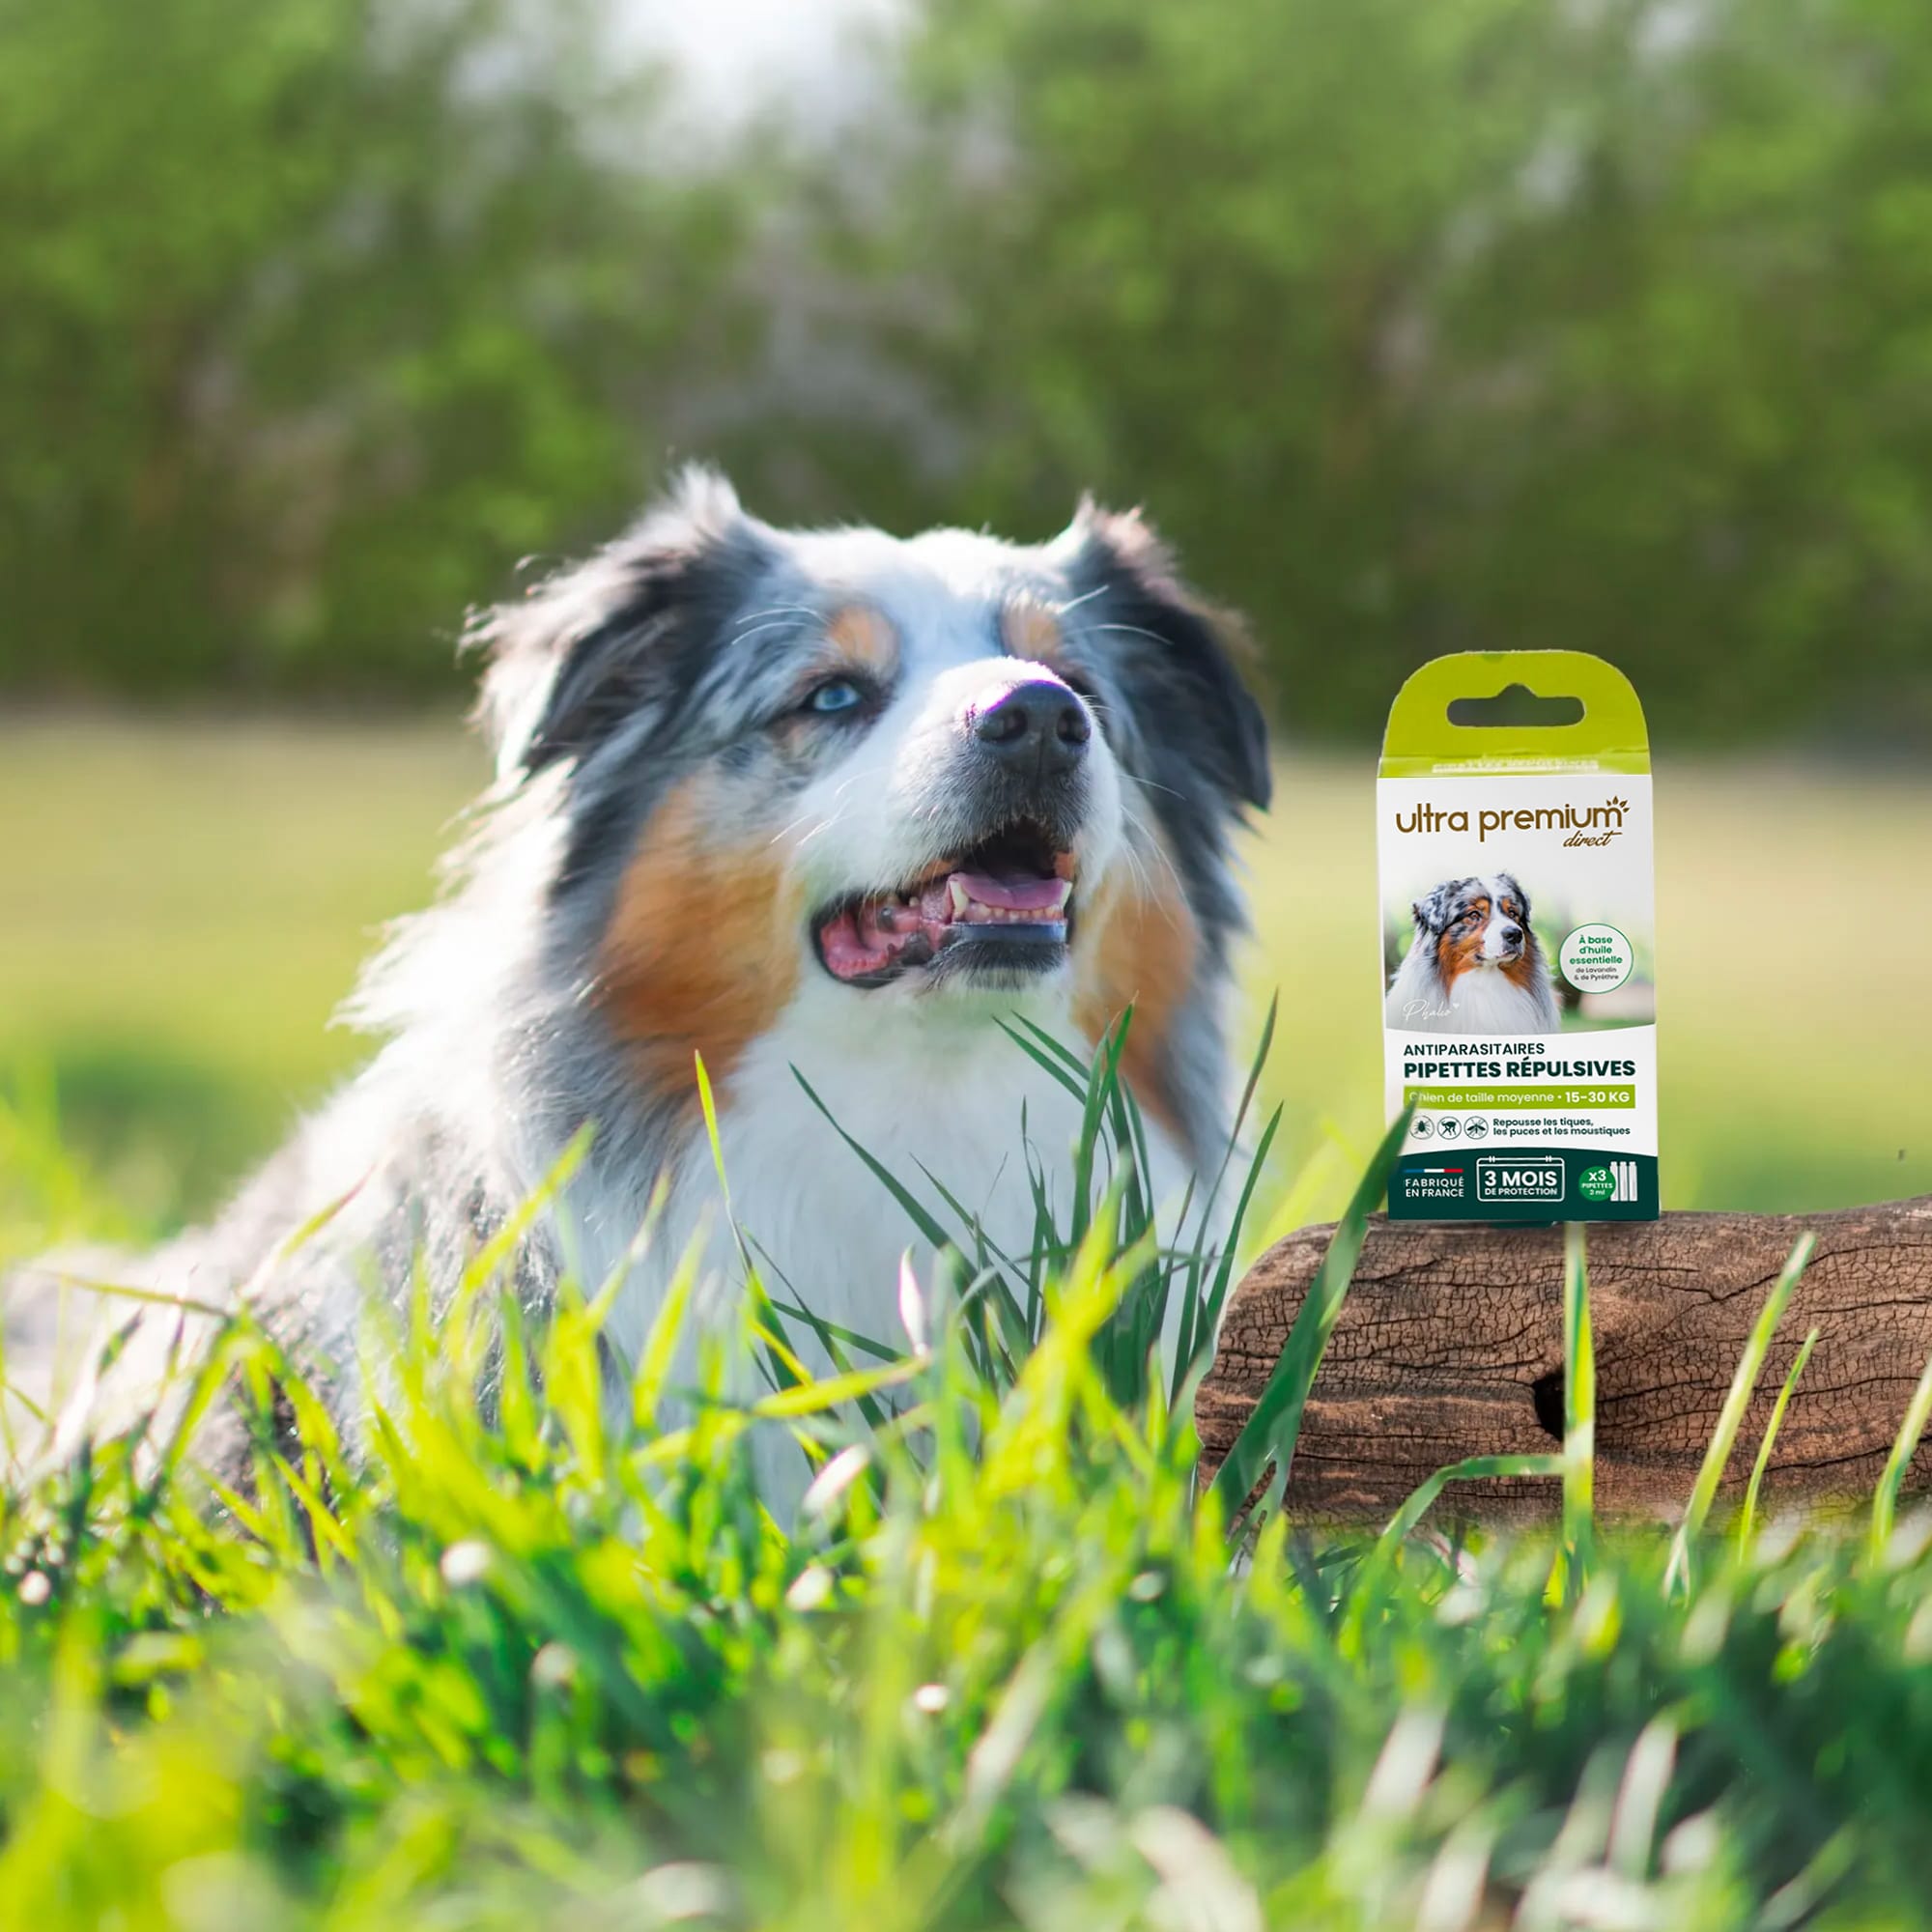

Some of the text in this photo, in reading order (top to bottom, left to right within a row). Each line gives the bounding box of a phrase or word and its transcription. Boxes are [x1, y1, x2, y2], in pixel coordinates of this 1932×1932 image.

[1396, 803, 1622, 842] ultra premium
[1563, 831, 1622, 847] direct
[1579, 946, 1612, 954] d'huile
[1569, 955, 1623, 964] essentielle
[1404, 1043, 1545, 1056] ANTIPARASITAIRES
[1404, 1056, 1635, 1078] PIPETTES RÉPULSIVES
[1447, 1093, 1463, 1102] de
[1465, 1093, 1494, 1102] taille
[1497, 1094, 1554, 1104] moyenne
[1608, 1092, 1630, 1102] KG
[1493, 1119, 1542, 1127] Repousse
[1560, 1118, 1594, 1127] tiques,
[1493, 1127, 1507, 1136] les
[1510, 1128, 1540, 1137] puces
[1571, 1126, 1631, 1137] moustiques
[1485, 1171, 1557, 1186] 3 MOIS
[1588, 1170, 1606, 1181] x3
[1406, 1177, 1464, 1187] FABRIQUÉ
[1498, 1187, 1557, 1196] PROTECTION
